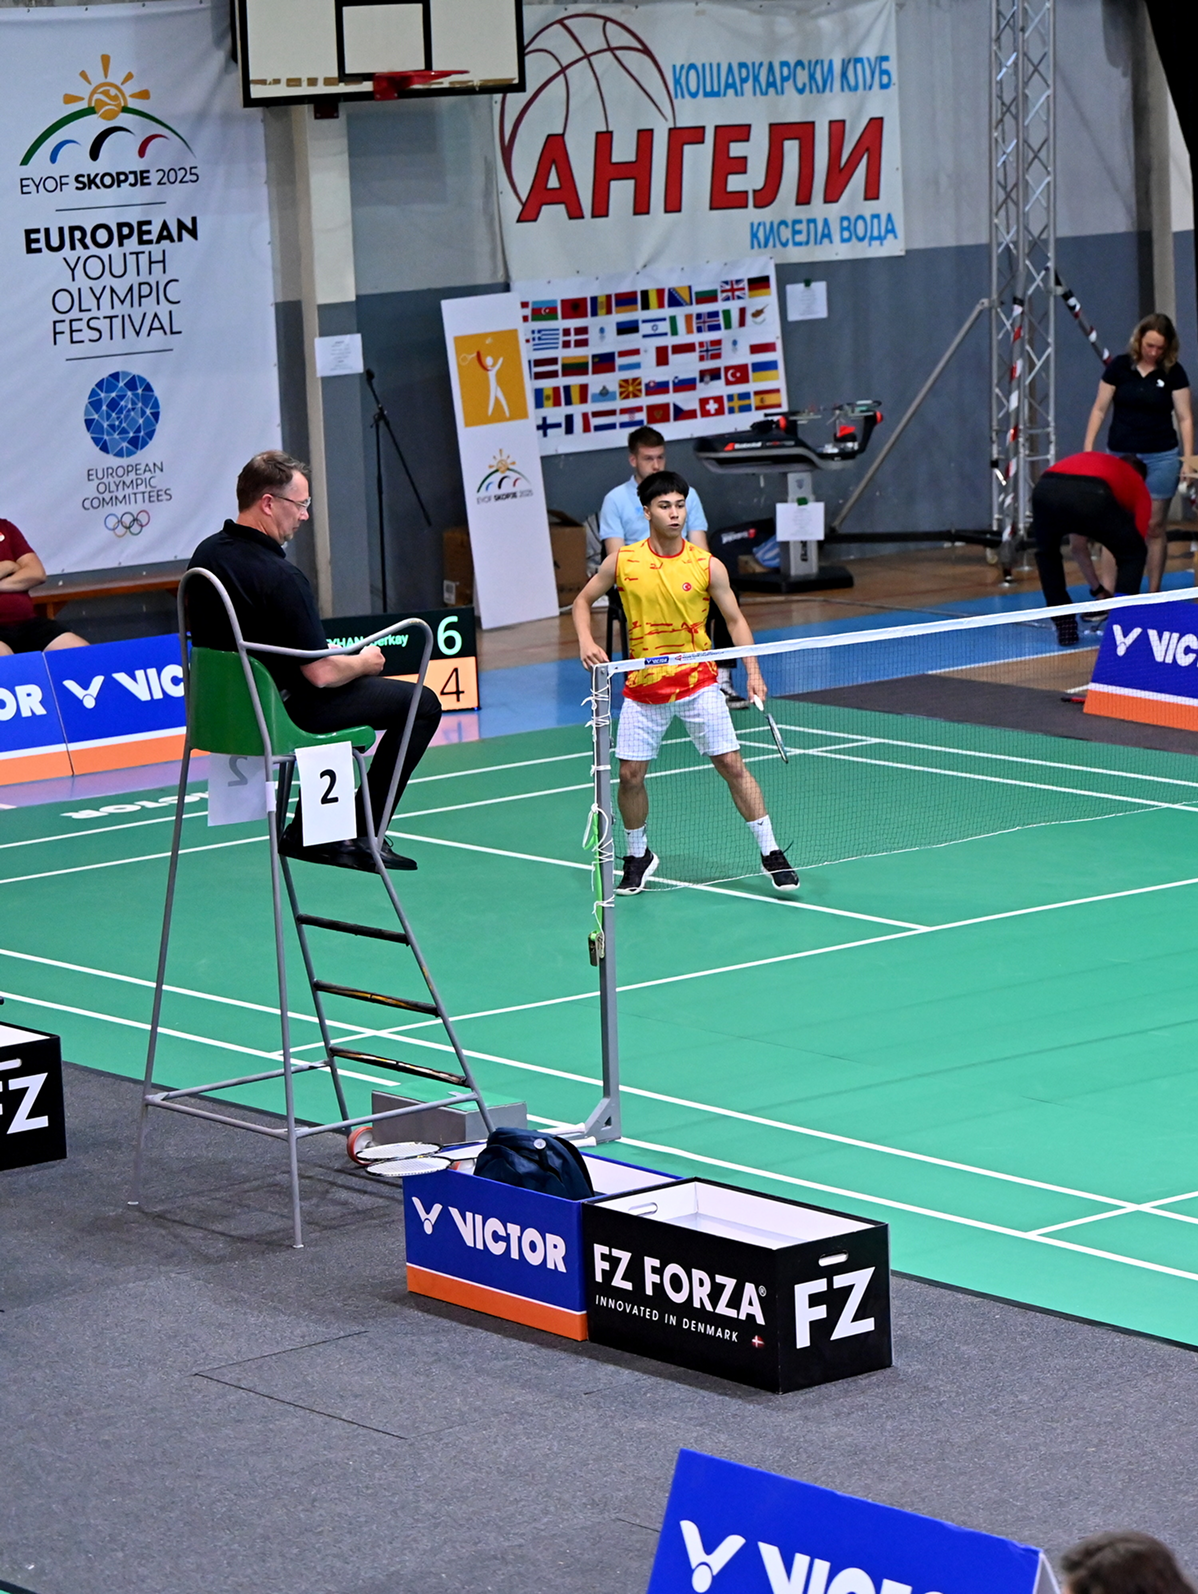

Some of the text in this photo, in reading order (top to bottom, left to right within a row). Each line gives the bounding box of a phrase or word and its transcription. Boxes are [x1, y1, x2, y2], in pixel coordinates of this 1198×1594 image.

[672, 55, 892, 99] КОШАРКАРСКИ КЛУБ
[20, 166, 200, 195] EYOF SKOPJE 2025
[516, 117, 884, 223] АНГЕЛИ
[24, 216, 198, 254] EUROPEAN
[750, 213, 898, 249] КИСЕЛА ВОДА
[63, 249, 166, 282] YOUTH
[52, 279, 181, 314] OLYMPIC
[52, 310, 182, 346] FESTIVAL
[87, 461, 164, 482] EUROPEAN
[96, 476, 157, 494] OLYMPIC
[82, 488, 173, 510] COMMITTEES
[370, 634, 409, 647] erkay
[436, 615, 463, 656] 6
[439, 667, 465, 702] 4
[319, 768, 339, 805] 2
[448, 1206, 567, 1273] VICTOR
[593, 1243, 633, 1291] FZ
[595, 1294, 739, 1343] INNOVATED IN DENMARK
[794, 1266, 876, 1349] FZ
